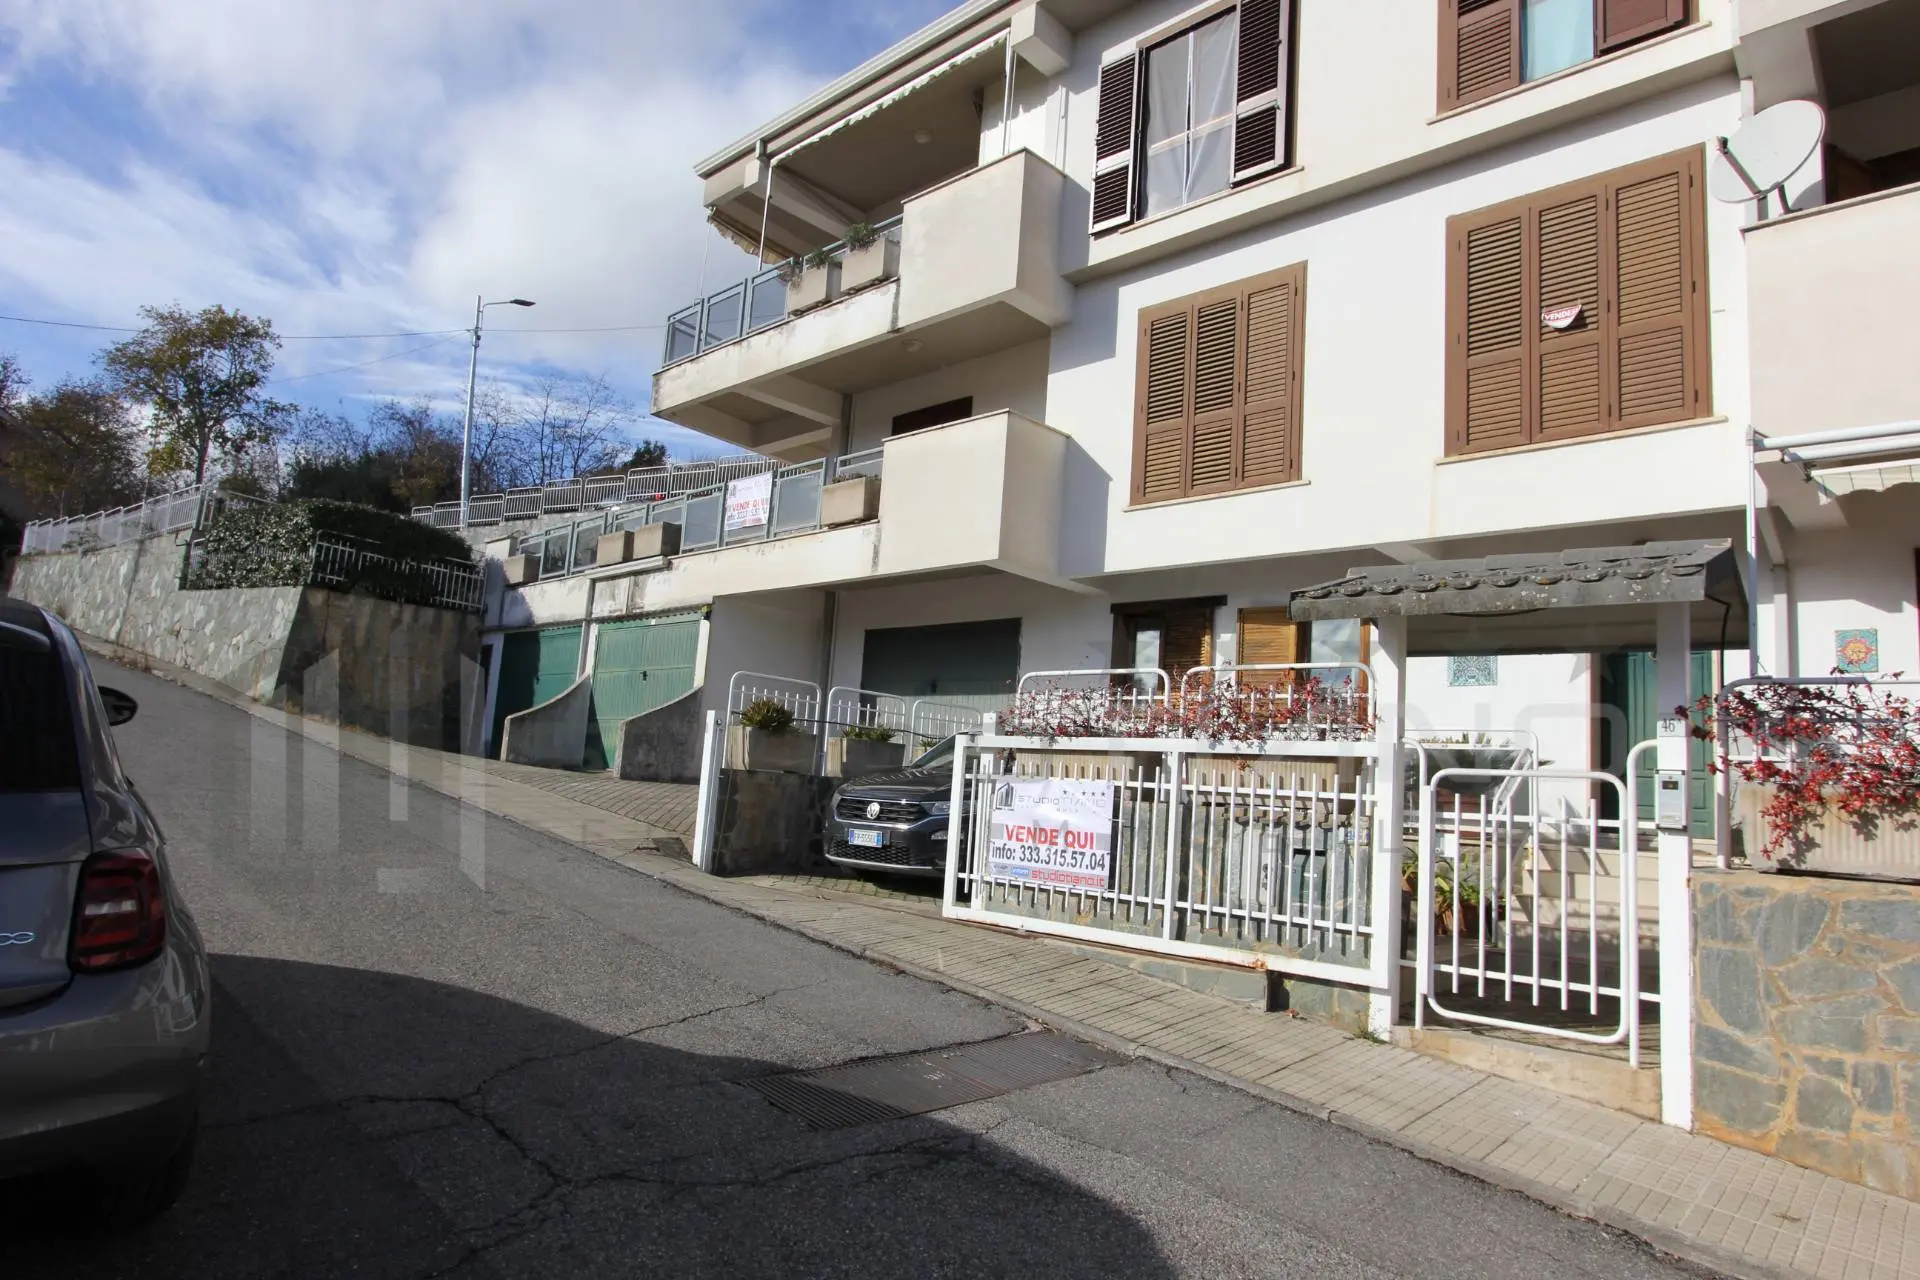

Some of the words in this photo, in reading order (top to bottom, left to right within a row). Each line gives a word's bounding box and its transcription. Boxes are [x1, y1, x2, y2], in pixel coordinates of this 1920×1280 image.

[1005, 824, 1059, 846] VENDE
[1064, 830, 1094, 849] QUI
[992, 841, 1015, 860] info:
[1019, 845, 1105, 871] 333.315.57.04
